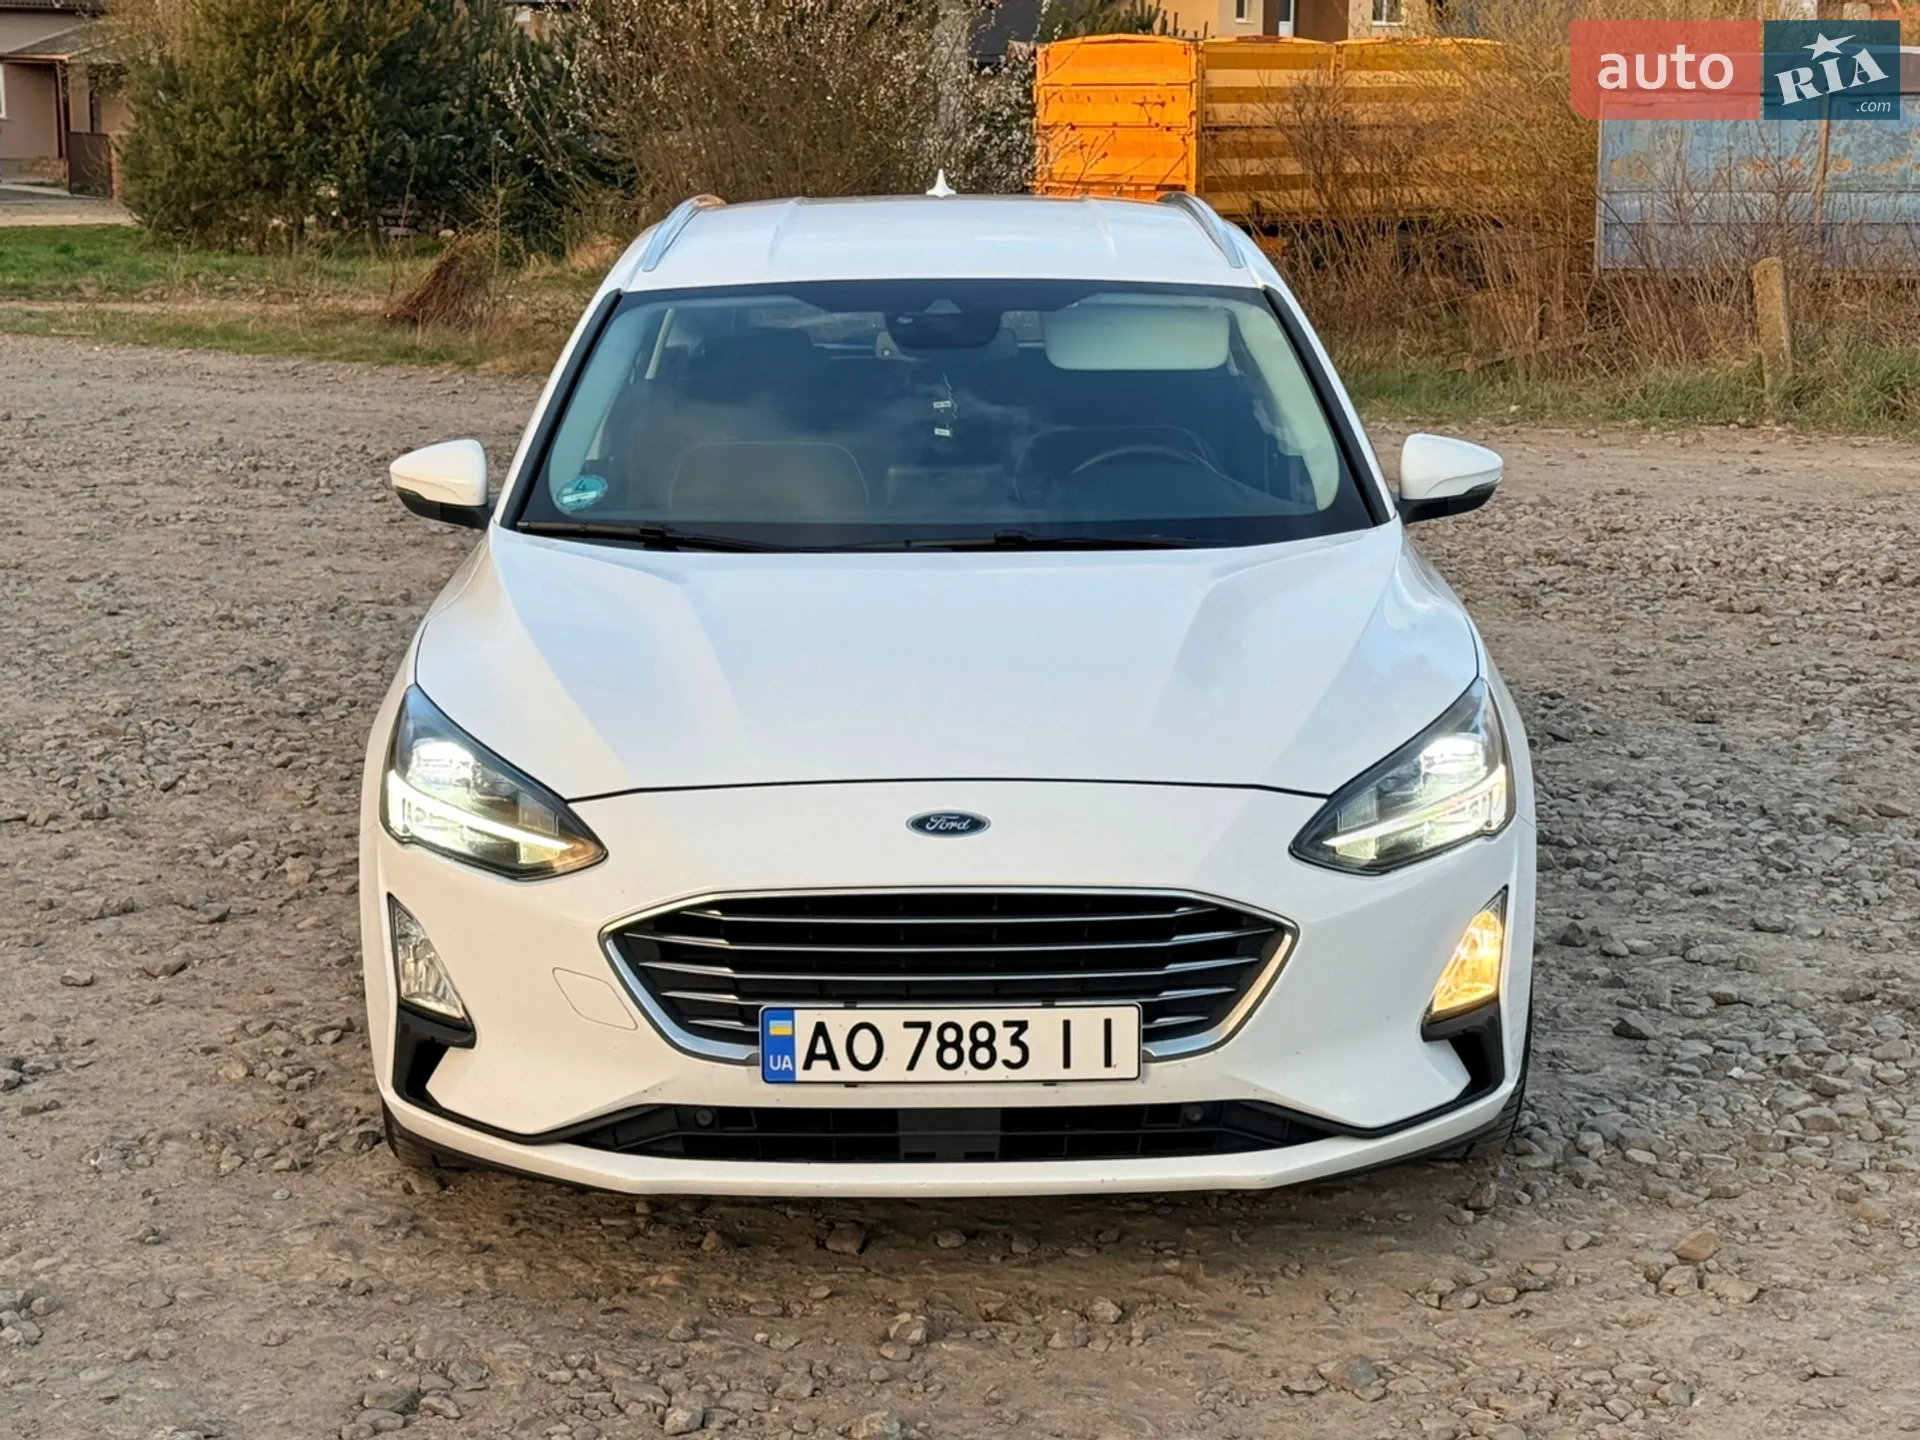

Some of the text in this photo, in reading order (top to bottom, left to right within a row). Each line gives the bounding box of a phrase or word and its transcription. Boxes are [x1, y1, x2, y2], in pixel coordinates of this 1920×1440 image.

[925, 814, 971, 831] Ford
[802, 1021, 884, 1072] AO
[903, 1020, 1030, 1071] 7883
[769, 1055, 793, 1071] UA
